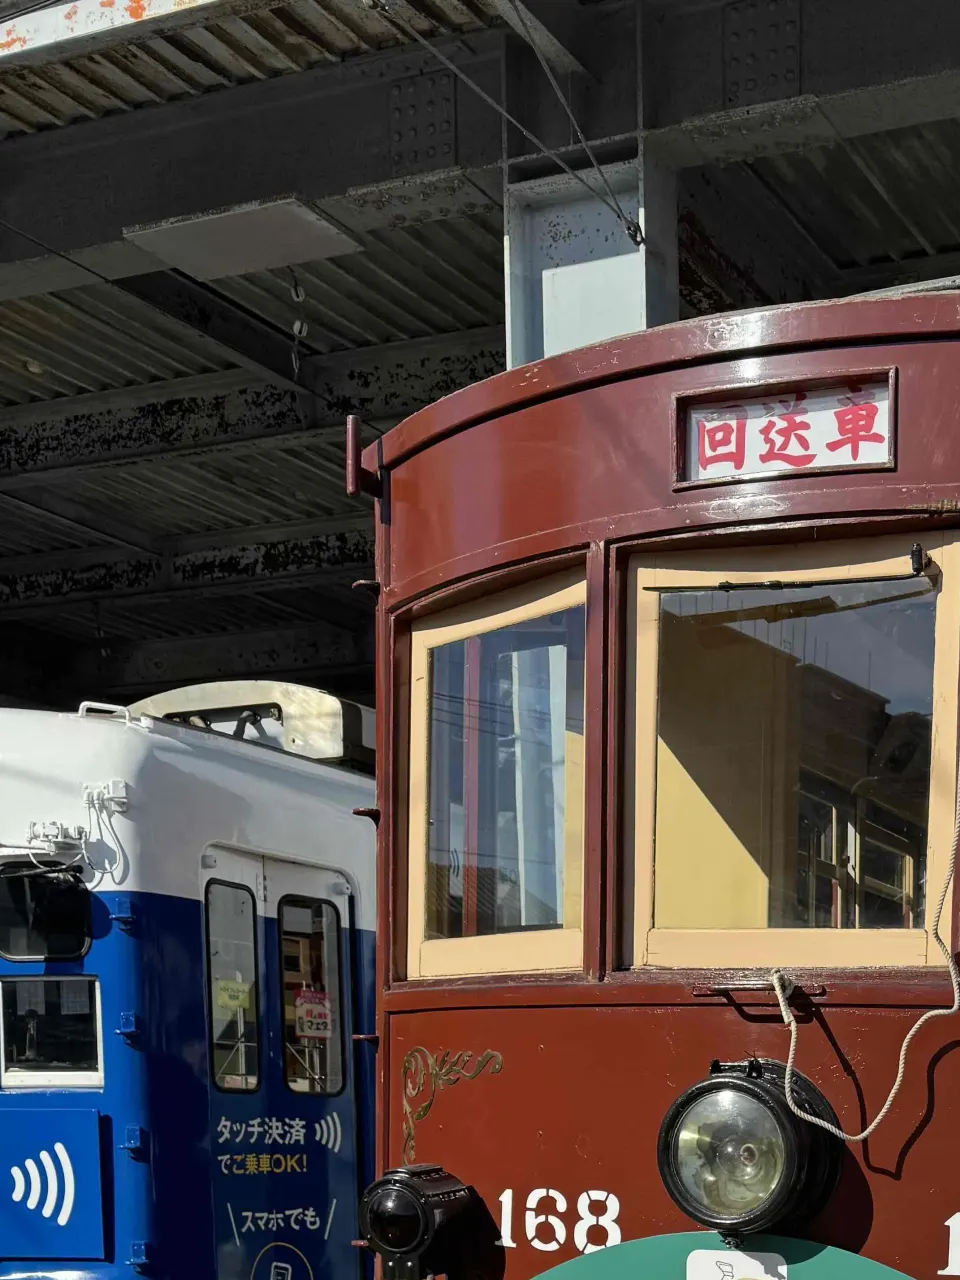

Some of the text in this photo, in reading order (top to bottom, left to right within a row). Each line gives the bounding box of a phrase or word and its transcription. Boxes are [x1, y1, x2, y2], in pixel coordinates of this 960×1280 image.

[697, 384, 886, 470] 回送車
[217, 1116, 306, 1145] タッチ決済
[217, 1154, 307, 1174] でご乗車OK!
[241, 1207, 320, 1233] スマホでも
[496, 1188, 622, 1254] 168
